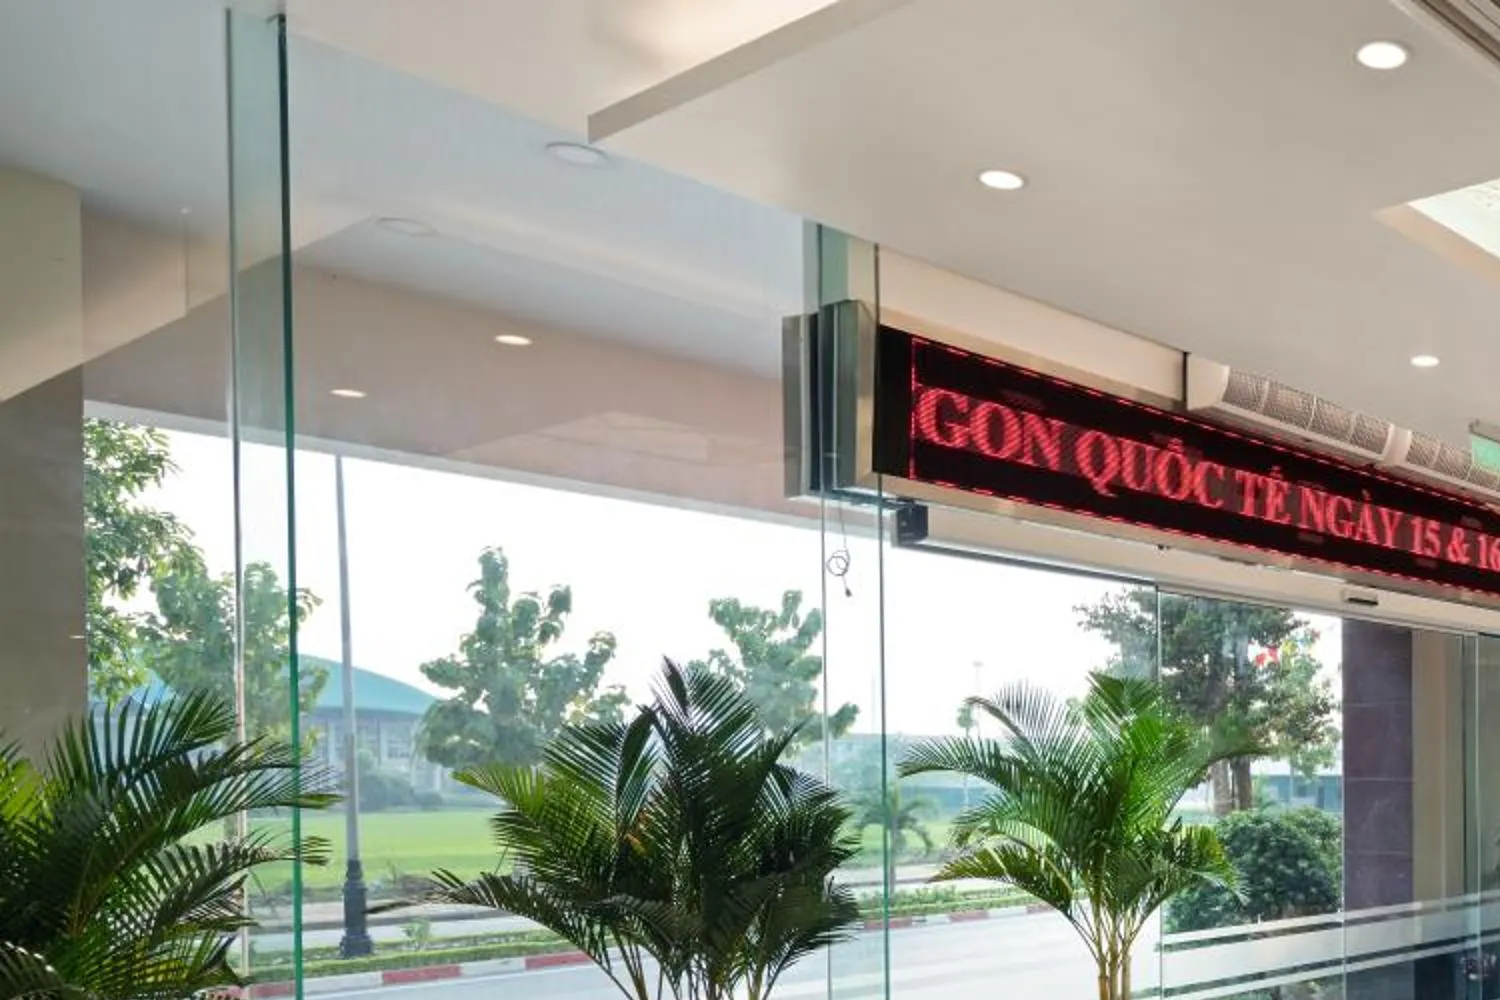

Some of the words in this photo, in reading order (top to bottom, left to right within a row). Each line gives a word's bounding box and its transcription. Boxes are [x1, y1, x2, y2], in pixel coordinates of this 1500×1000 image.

[1299, 485, 1403, 550] NGÀY
[1410, 516, 1443, 560] 15
[1446, 526, 1471, 565] &
